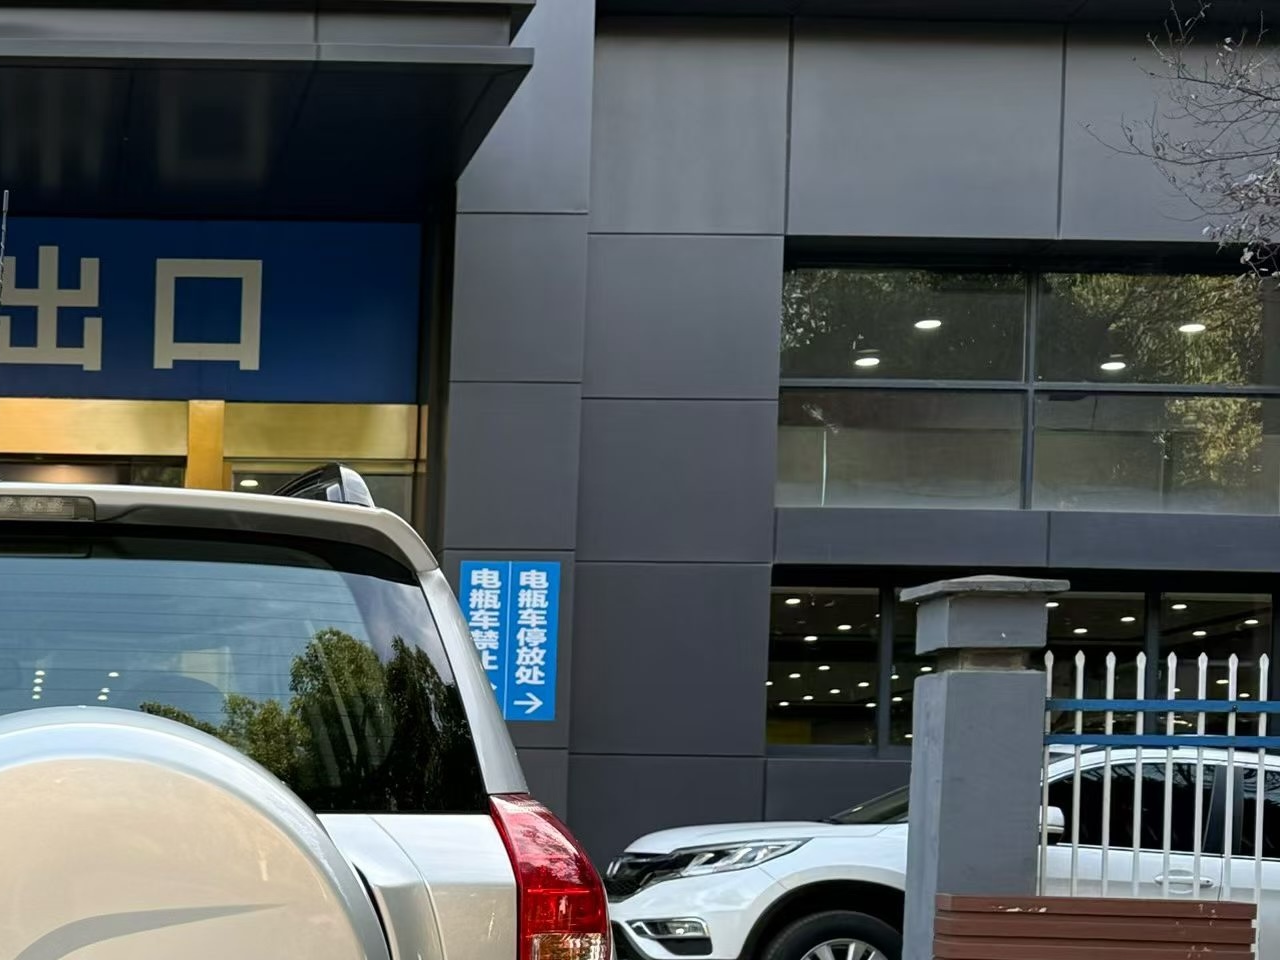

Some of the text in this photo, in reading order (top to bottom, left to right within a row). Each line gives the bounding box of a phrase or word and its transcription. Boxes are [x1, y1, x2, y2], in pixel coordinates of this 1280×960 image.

[468, 568, 502, 690] 电瓶车禁止
[515, 569, 549, 686] 电瓶车停放处
